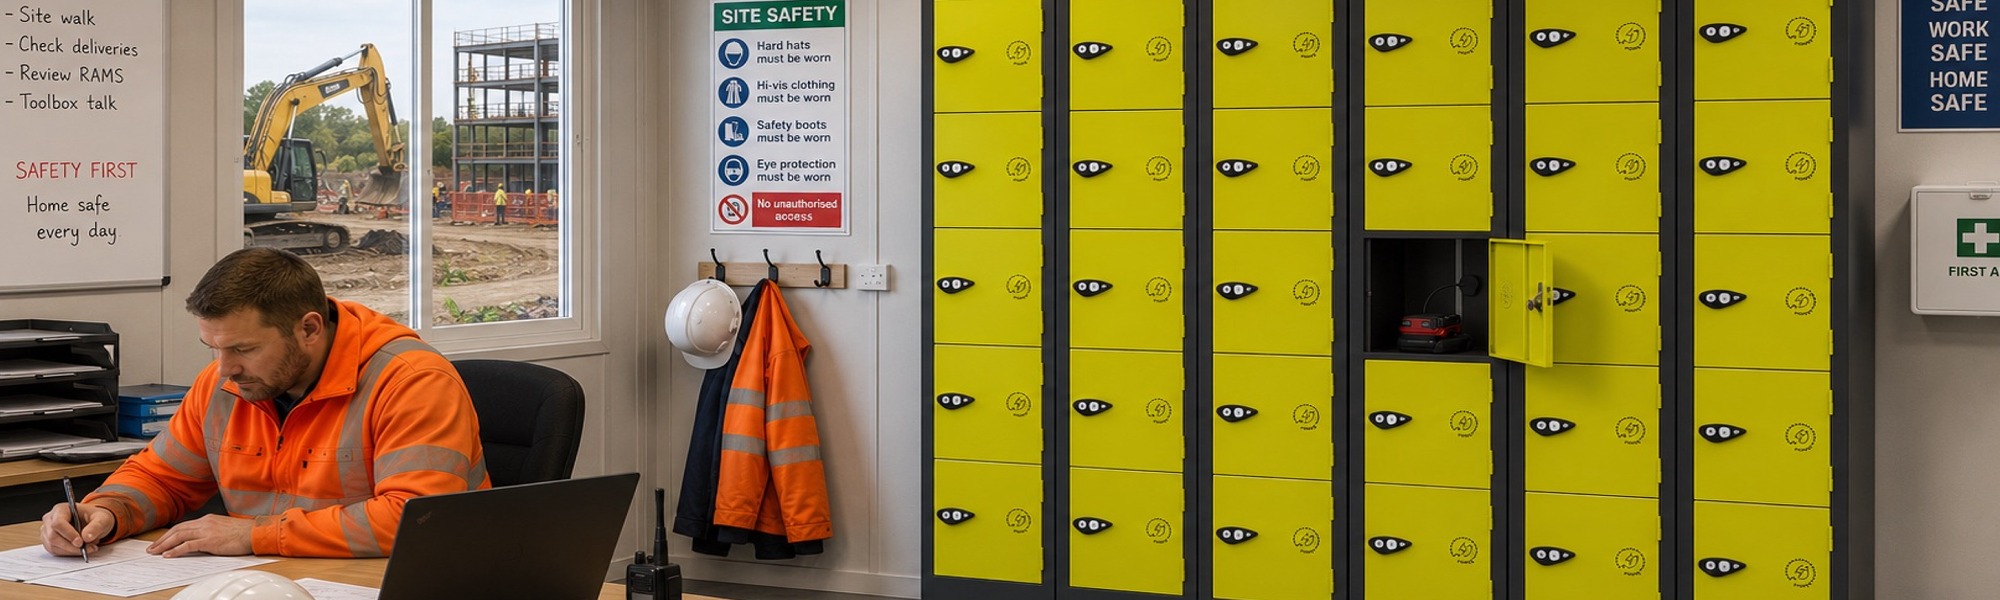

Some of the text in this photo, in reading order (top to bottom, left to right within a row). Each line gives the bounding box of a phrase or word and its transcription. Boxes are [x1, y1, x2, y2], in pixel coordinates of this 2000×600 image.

[20, 6, 95, 25] Site walk
[722, 6, 837, 24] SITE SAFETY
[1929, 21, 1989, 38] WORK
[19, 35, 138, 57] Check deliveries
[756, 40, 811, 50] Hard hats
[1931, 43, 1987, 61] SAFE
[756, 53, 832, 63] must be worn
[20, 64, 124, 83] Review RAMS
[1931, 71, 1988, 87] HOME
[756, 80, 836, 91] Hi-vis clothing
[20, 93, 117, 110] Toolbox talk
[756, 92, 832, 103] must be worn
[1931, 94, 1987, 111] SAFE
[756, 119, 828, 132] Safety boots
[756, 132, 832, 142] must be worn
[16, 161, 138, 179] SAFETY FIRST
[756, 159, 837, 171] Eye protection
[756, 171, 832, 181] must be worn
[28, 194, 110, 215] Home safe
[757, 198, 772, 208] No
[37, 221, 116, 246] every day
[1949, 266, 1987, 276] FIRST
